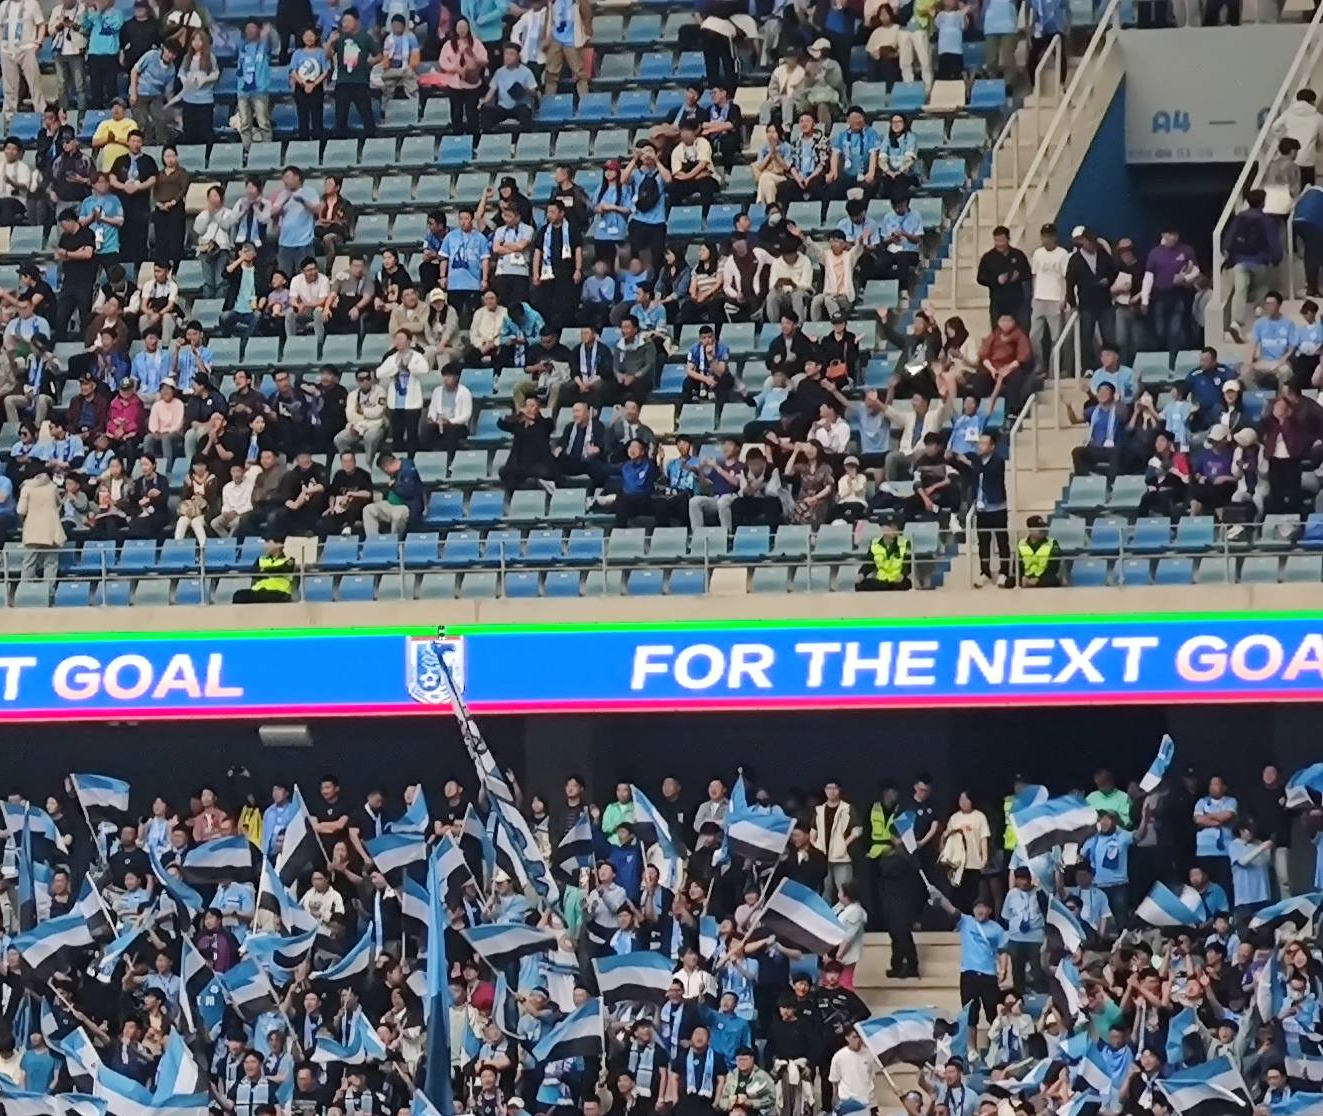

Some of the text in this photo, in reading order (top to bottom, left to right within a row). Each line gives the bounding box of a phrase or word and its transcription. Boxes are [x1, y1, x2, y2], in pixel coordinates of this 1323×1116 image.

[1152, 110, 1192, 134] A4
[53, 654, 243, 700] GOAL
[631, 644, 774, 689] FOR
[796, 641, 938, 687] THE
[956, 637, 1158, 684] NEXT
